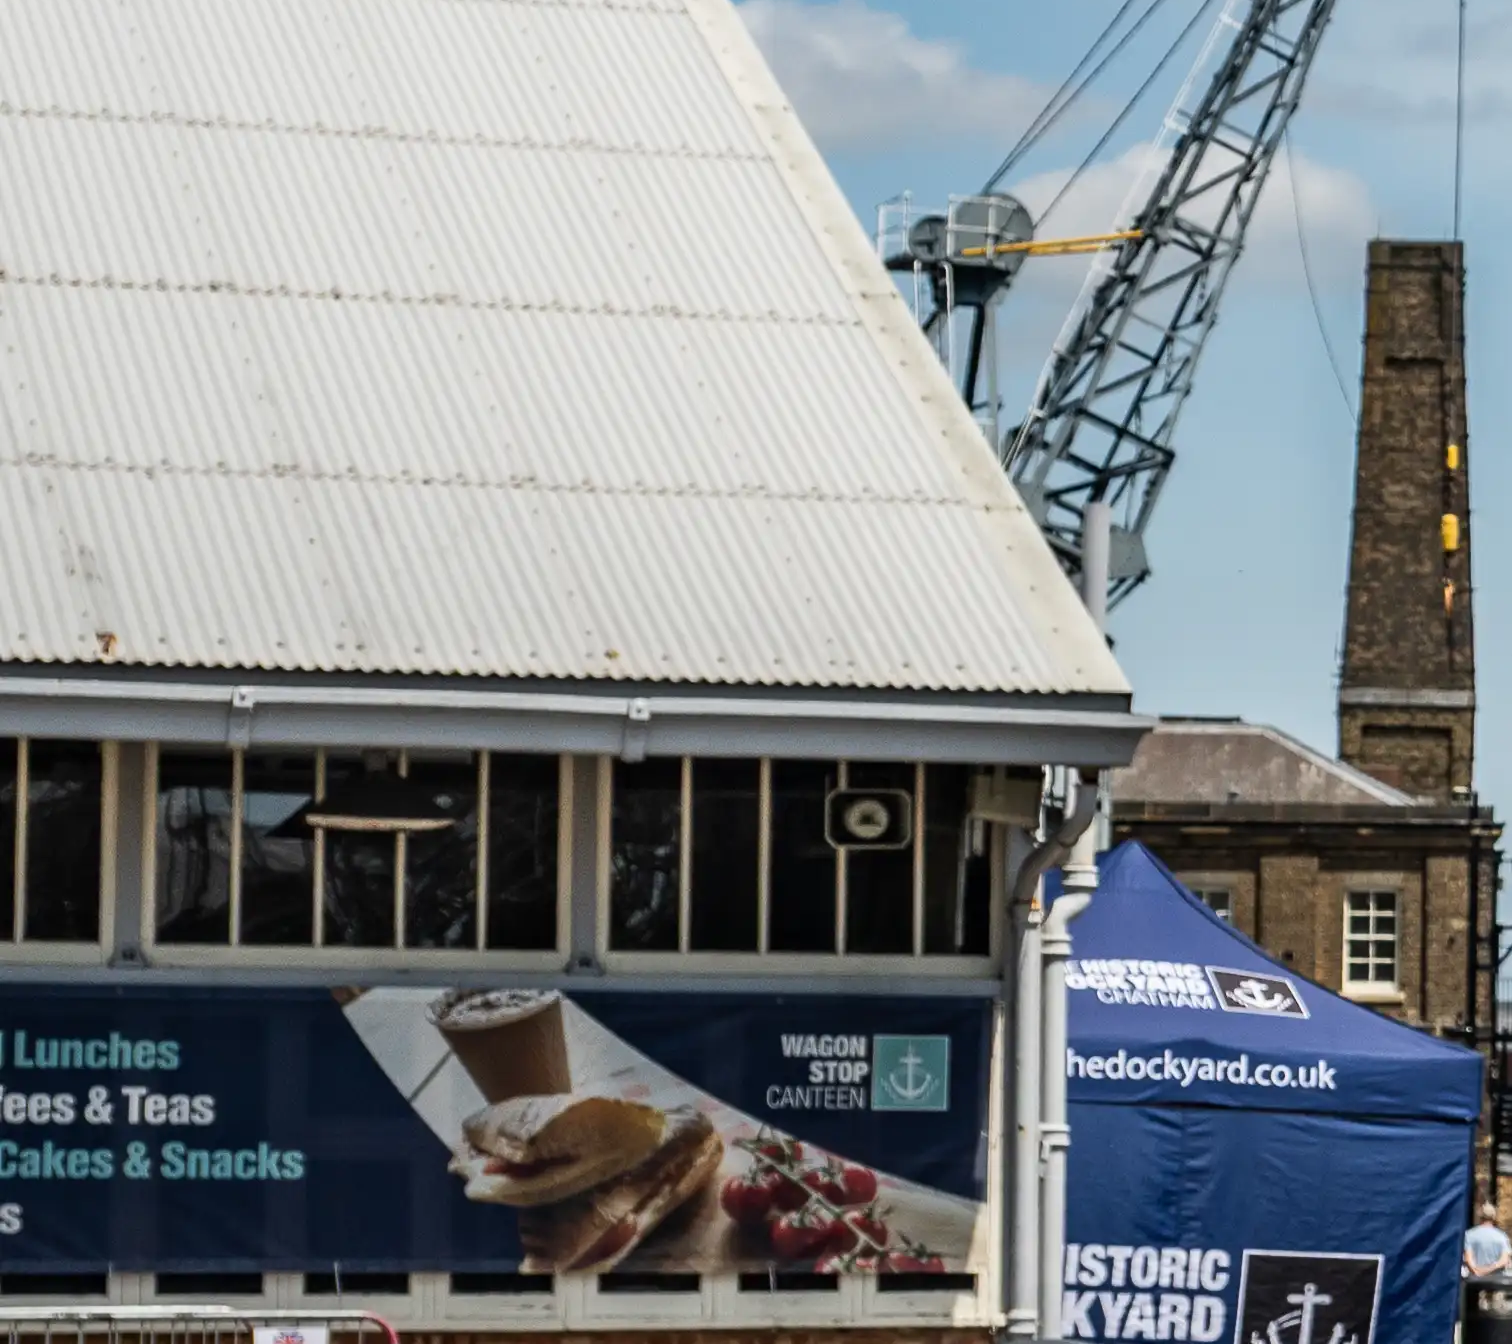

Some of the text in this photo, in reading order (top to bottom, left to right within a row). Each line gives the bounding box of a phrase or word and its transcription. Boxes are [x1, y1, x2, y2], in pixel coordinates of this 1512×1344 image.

[1065, 973, 1211, 996] OCKYARD
[1080, 959, 1204, 979] HISTORIC
[1096, 988, 1217, 1010] CHATHAM
[14, 1030, 180, 1070] Lunches
[780, 1034, 867, 1057] WAGON
[808, 1060, 869, 1083] STOP
[1066, 1048, 1337, 1090] hedockyard.co.uk
[0, 1084, 215, 1126] ees & Teas
[766, 1086, 866, 1109] CANTEEN
[0, 1139, 304, 1180] Cakes & Snacks
[1063, 1243, 1231, 1291] ISTORIC
[1062, 1290, 1227, 1343] KYARD
